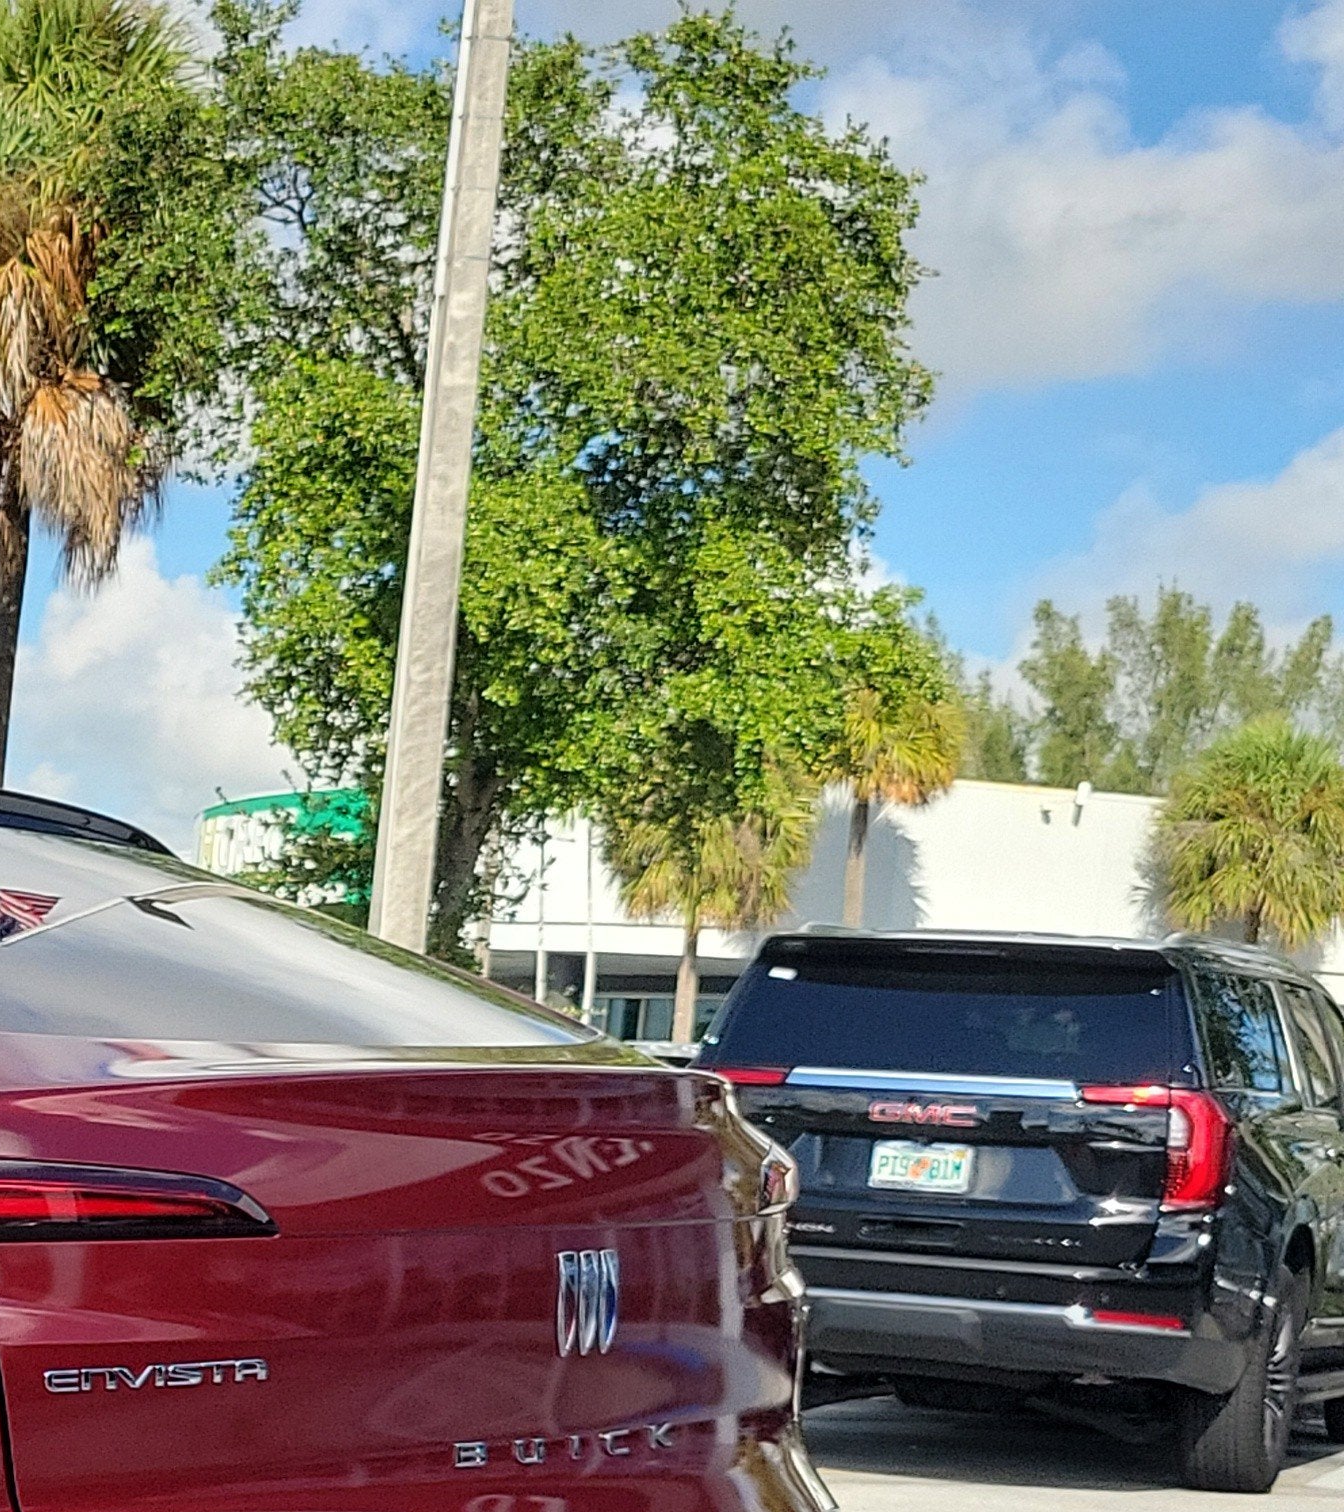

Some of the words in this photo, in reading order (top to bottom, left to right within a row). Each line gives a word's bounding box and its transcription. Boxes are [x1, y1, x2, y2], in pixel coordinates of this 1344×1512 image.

[868, 1101, 977, 1128] GMC
[43, 1358, 269, 1393] ENVISTA
[453, 1422, 672, 1468] BUICK
